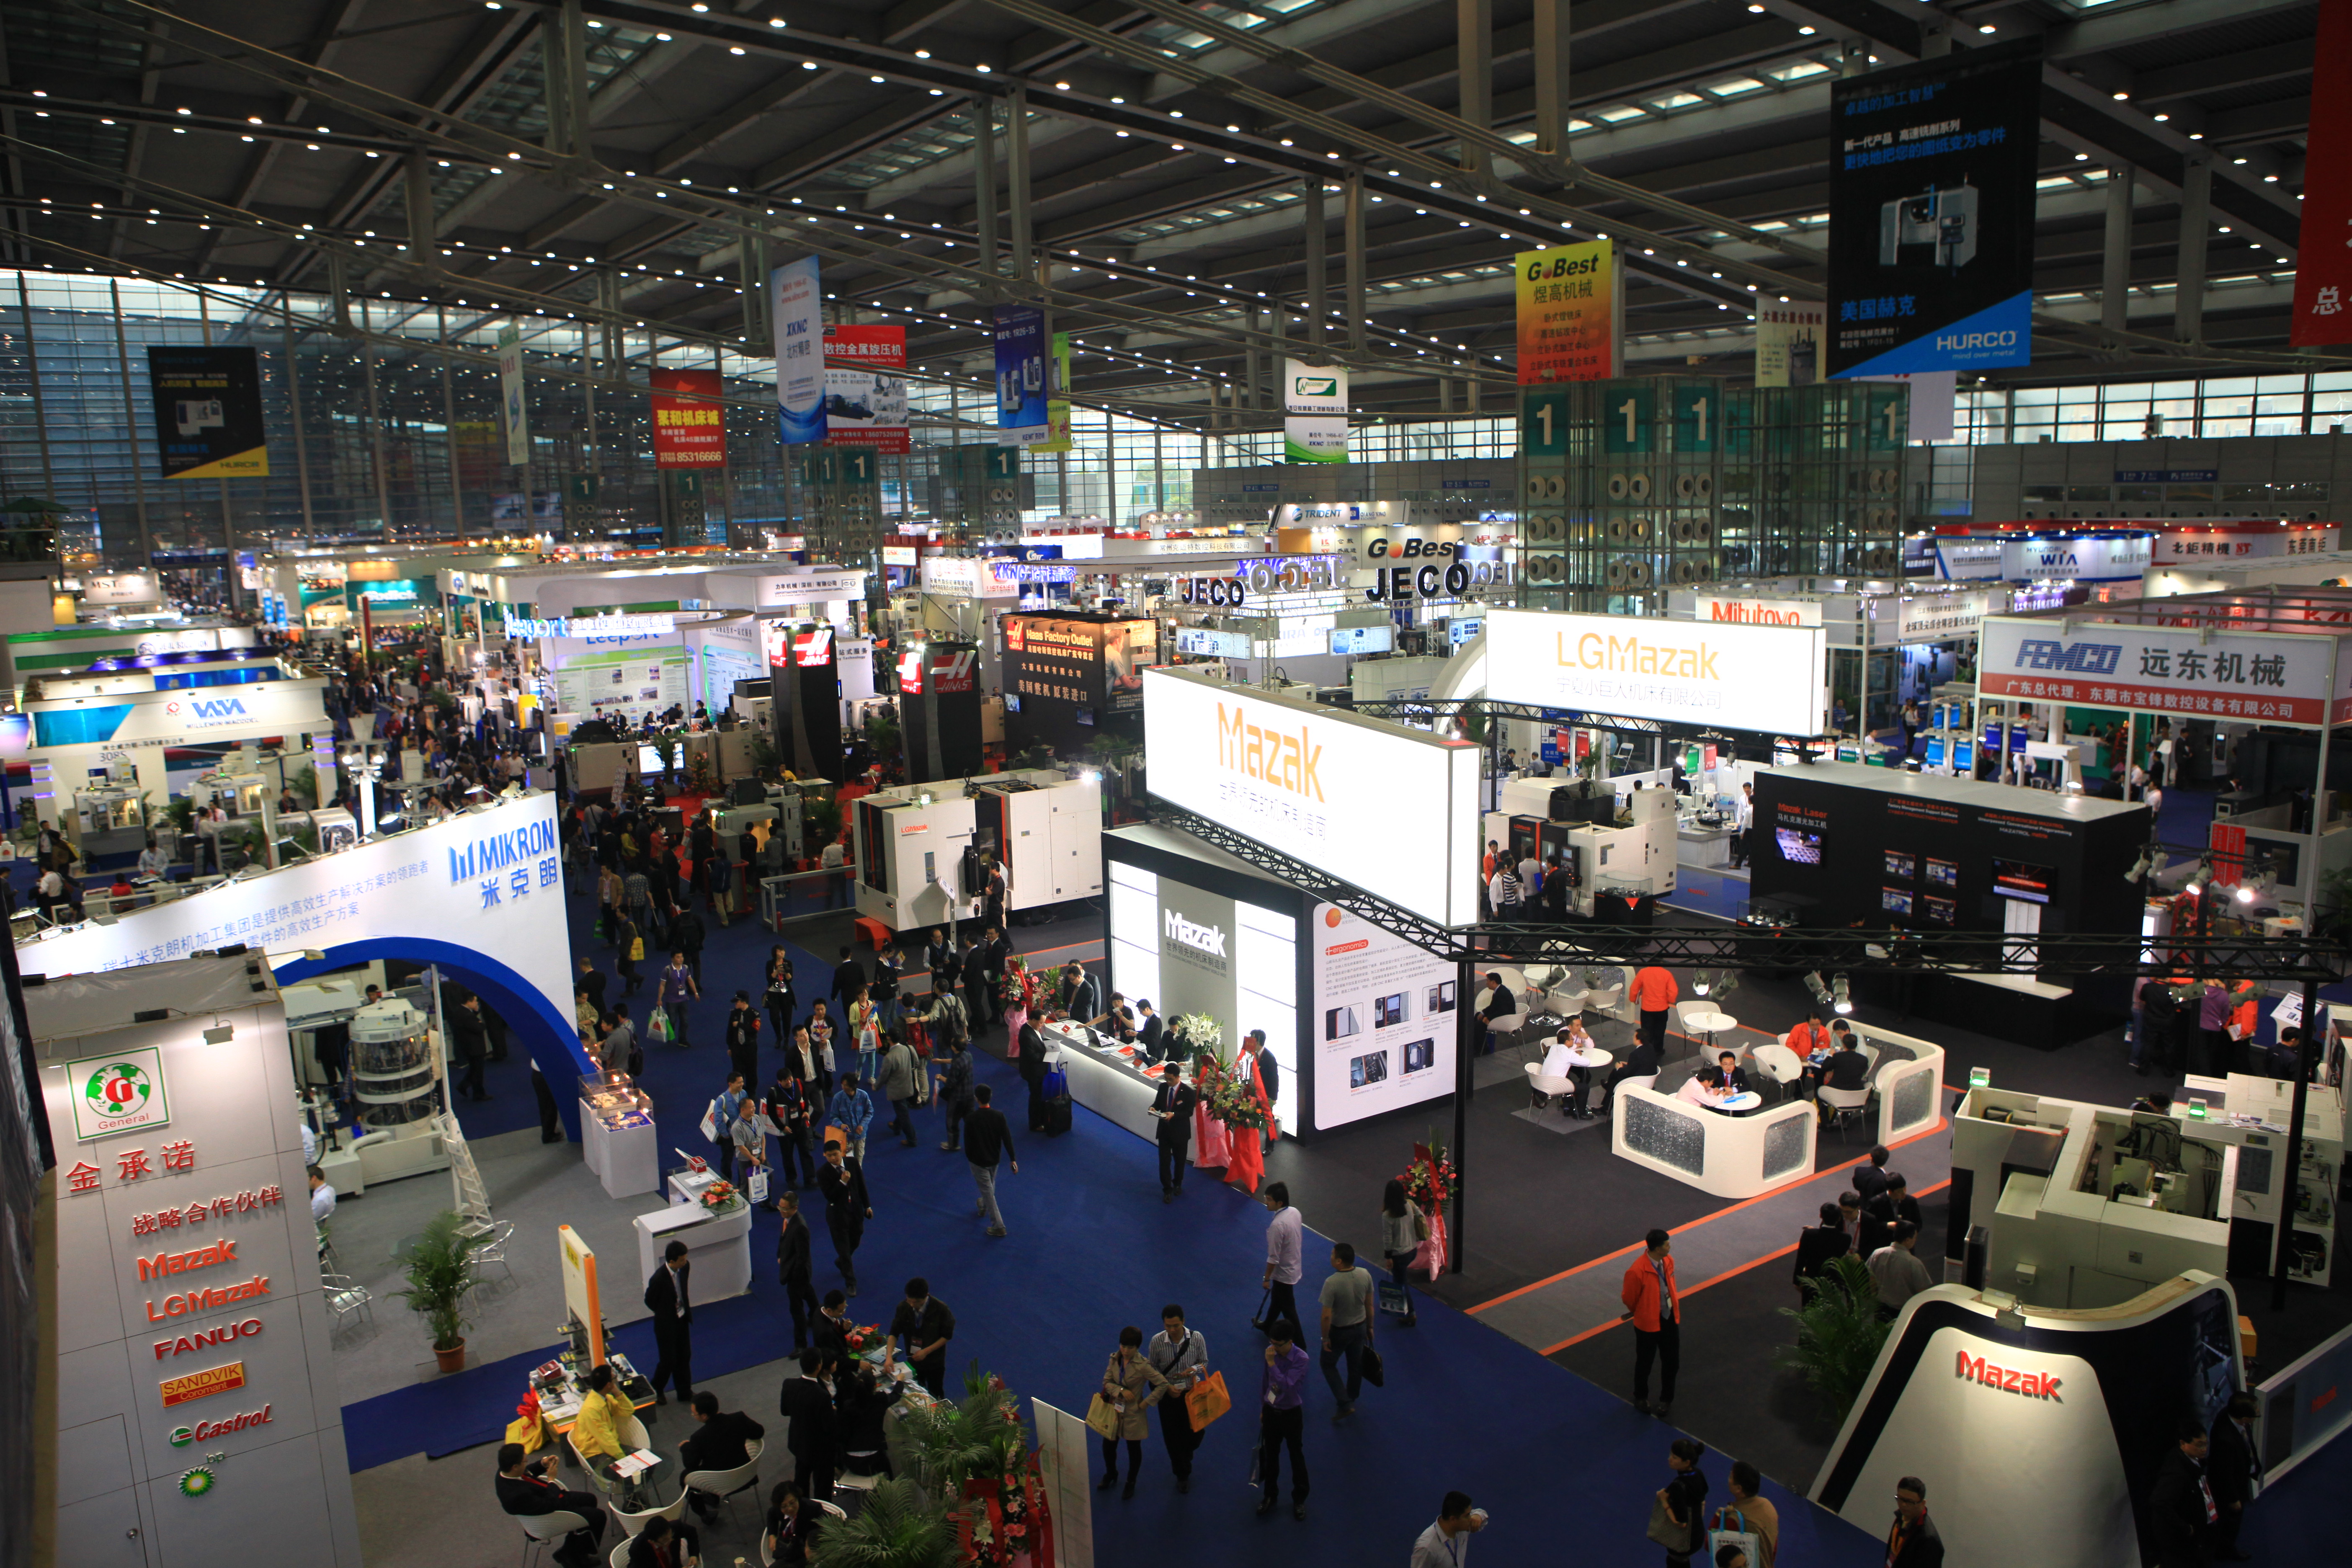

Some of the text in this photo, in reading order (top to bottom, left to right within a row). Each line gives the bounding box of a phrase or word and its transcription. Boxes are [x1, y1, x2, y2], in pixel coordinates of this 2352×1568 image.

[1533, 279, 1594, 304] 煜高机械
[1840, 294, 1916, 322] 美国赫克
[787, 319, 808, 337] XKNC
[823, 343, 902, 356] 数控金属旋压机
[1937, 331, 2017, 351] HURCO
[1952, 351, 1972, 359] mind
[1993, 348, 2016, 357] metal
[657, 410, 720, 426] 聚和机床城
[1537, 404, 1552, 445] 1
[1619, 399, 1635, 442] 1
[1692, 397, 1707, 441] 1
[1883, 402, 1896, 441] 1
[676, 451, 722, 462] 85316666
[824, 457, 831, 479] 1
[855, 455, 866, 478] 1
[997, 451, 1008, 474] 1
[803, 459, 810, 481] 1
[580, 478, 590, 494] 1
[685, 476, 694, 491] 1
[1305, 509, 1342, 518] TRIDENT
[1160, 542, 1250, 552] 常州克迈特数控科技有限公司
[2040, 551, 2078, 566] WIA
[91, 580, 119, 588] MST
[1181, 578, 1246, 607] JECO
[1365, 562, 1469, 602] JECO
[1712, 601, 1800, 626] Mitutoyo
[1026, 629, 1093, 647] Haas Factory Outlet
[797, 655, 830, 666] HAAS
[1556, 631, 1720, 680] LGMazak
[2014, 639, 2287, 688] FEMCO 远东机械
[935, 680, 973, 692] HAAS
[1018, 679, 1088, 702] 美国整机 原装进口
[1557, 676, 1722, 710] 宁夏小巨人机床有限公司
[2006, 681, 2293, 719] 广东总代理： 东莞市宝锋数控设备有限公司
[1217, 701, 1326, 803] Mazak
[1220, 782, 1326, 841] 世界领先的机床制造商
[1777, 813, 1828, 829] 马扎克激光加工机
[1778, 802, 1828, 820] Mazak Laser
[1901, 805, 1925, 814] Management
[1926, 808, 1940, 816] Support
[900, 823, 928, 833] LGMazak
[1999, 827, 2030, 837] MAZATROL
[478, 817, 556, 876] MIKRON
[480, 856, 558, 909] 米克朗
[1165, 908, 1227, 958] Mazak
[1166, 941, 1227, 972] 世界领先的机床制造商
[1332, 941, 1367, 953] ergonomics
[98, 1113, 150, 1130] General
[66, 1139, 196, 1192] 金承诺
[133, 1185, 282, 1236] 战略合作伙伴
[137, 1238, 238, 1281] Mazak
[145, 1275, 271, 1322] LGMazak
[153, 1318, 263, 1360] FANUC
[164, 1364, 241, 1395] SANDVIK
[1956, 1349, 2061, 1399] Mazak
[180, 1381, 227, 1400] Coromant
[206, 1451, 225, 1464] bp
